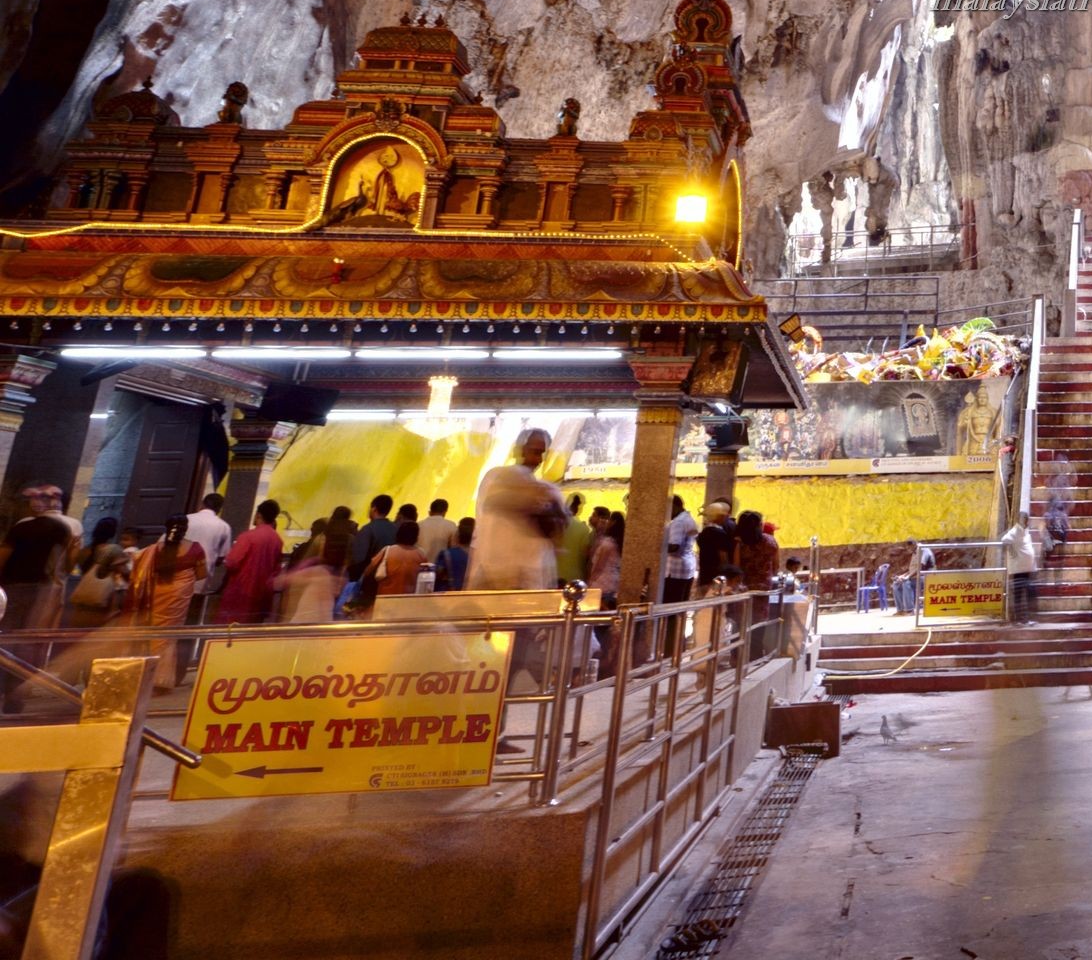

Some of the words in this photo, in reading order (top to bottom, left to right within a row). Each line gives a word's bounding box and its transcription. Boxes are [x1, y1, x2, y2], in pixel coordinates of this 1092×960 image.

[930, 595, 957, 605] MAIN
[960, 594, 1002, 603] TEMPLE
[208, 662, 500, 715] மூலஸ்தானம்
[200, 720, 314, 754] MAIN
[325, 714, 492, 749] TEMPLE
